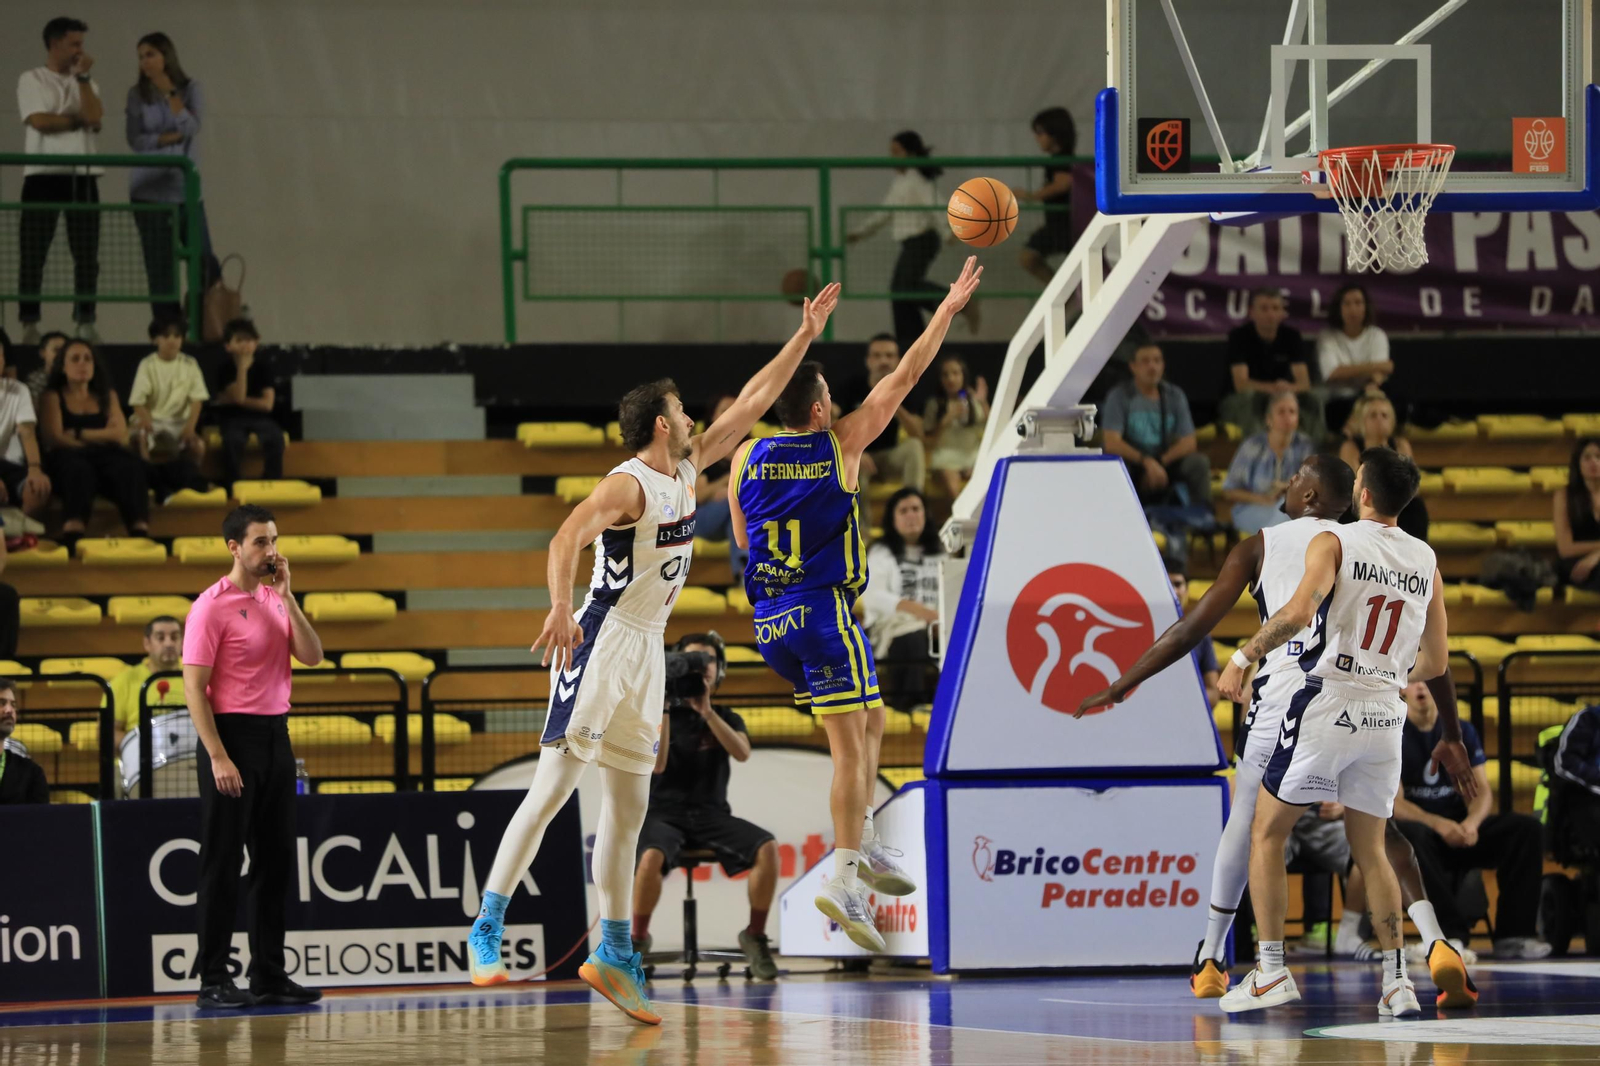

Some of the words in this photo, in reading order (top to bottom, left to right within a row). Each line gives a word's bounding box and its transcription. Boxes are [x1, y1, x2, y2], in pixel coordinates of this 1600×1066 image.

[1529, 165, 1550, 173] FEB
[1419, 286, 1482, 317] DE
[761, 460, 833, 480] FERNÁNDEZ
[762, 518, 804, 569] 11
[1353, 561, 1428, 597] MANCHÓN
[1360, 594, 1406, 655] 11
[994, 847, 1197, 876] BricoCentro
[1041, 880, 1200, 908] Paradelo
